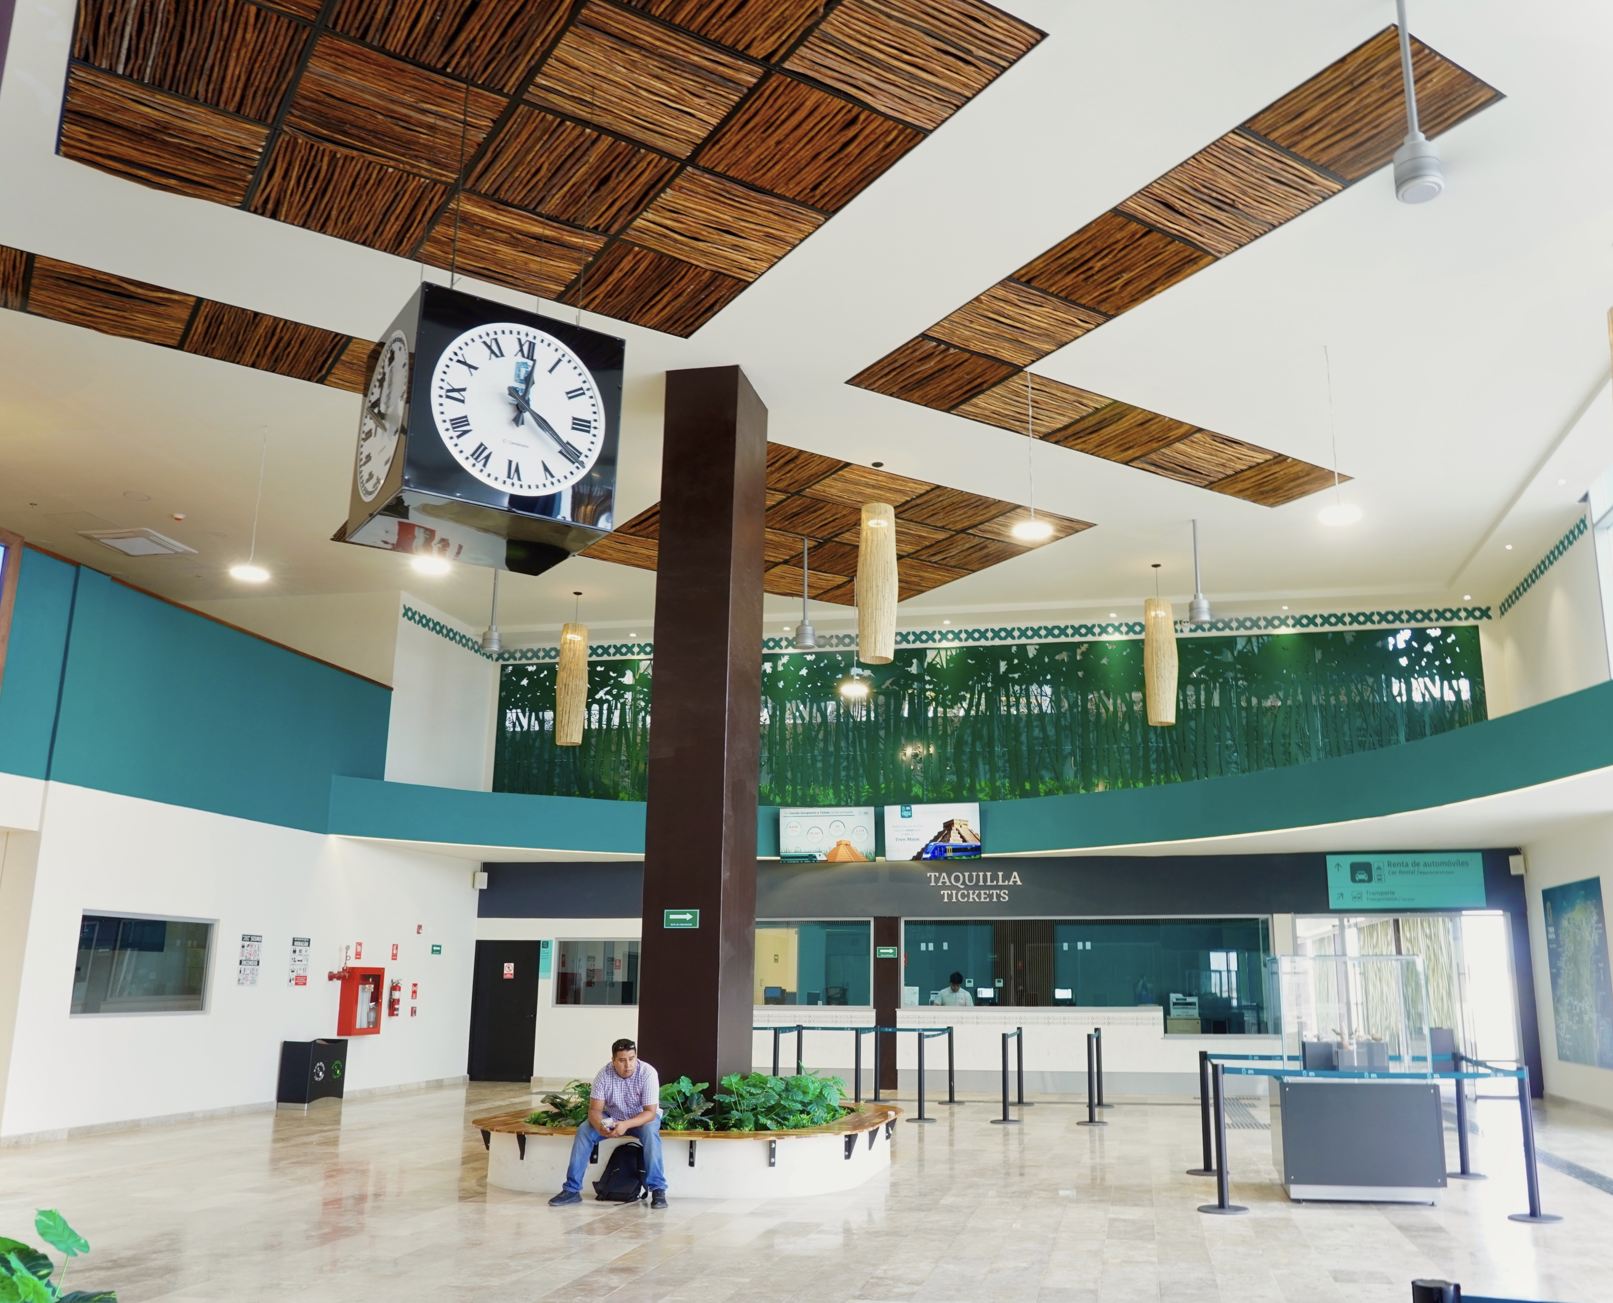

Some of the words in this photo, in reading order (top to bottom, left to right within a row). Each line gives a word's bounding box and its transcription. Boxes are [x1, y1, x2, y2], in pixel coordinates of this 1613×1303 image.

[514, 337, 536, 361] XII
[456, 353, 480, 376] X
[445, 381, 467, 404] IX
[565, 386, 586, 401] II
[449, 415, 473, 439] VIII
[571, 416, 592, 434] III
[470, 441, 493, 469] VII
[558, 440, 583, 465] III
[506, 458, 522, 482] VI
[540, 459, 556, 481] V
[1387, 860, 1409, 868] Renta
[1411, 860, 1421, 868] de
[927, 871, 1022, 888] TAQUILLA
[941, 889, 1009, 902] TICKETS
